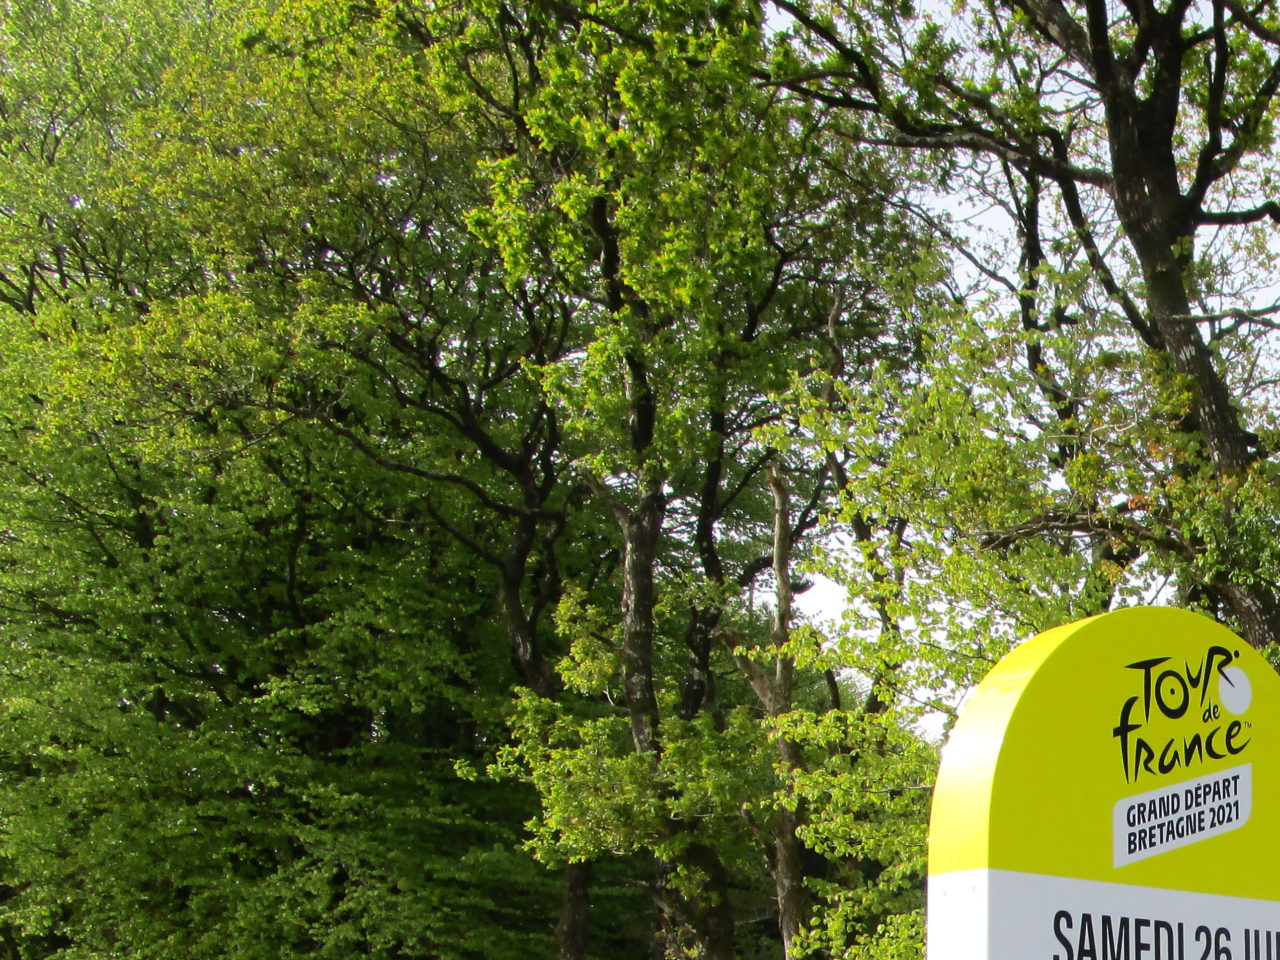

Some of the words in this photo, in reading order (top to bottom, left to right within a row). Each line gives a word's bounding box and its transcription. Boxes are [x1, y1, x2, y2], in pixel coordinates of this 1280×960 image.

[1124, 645, 1240, 725] TOUR
[1202, 697, 1221, 723] de
[1126, 792, 1180, 828] GRAND
[1184, 773, 1240, 811] DÉPART
[1127, 810, 1206, 855] BRETAGNE
[1209, 799, 1240, 829] 2021
